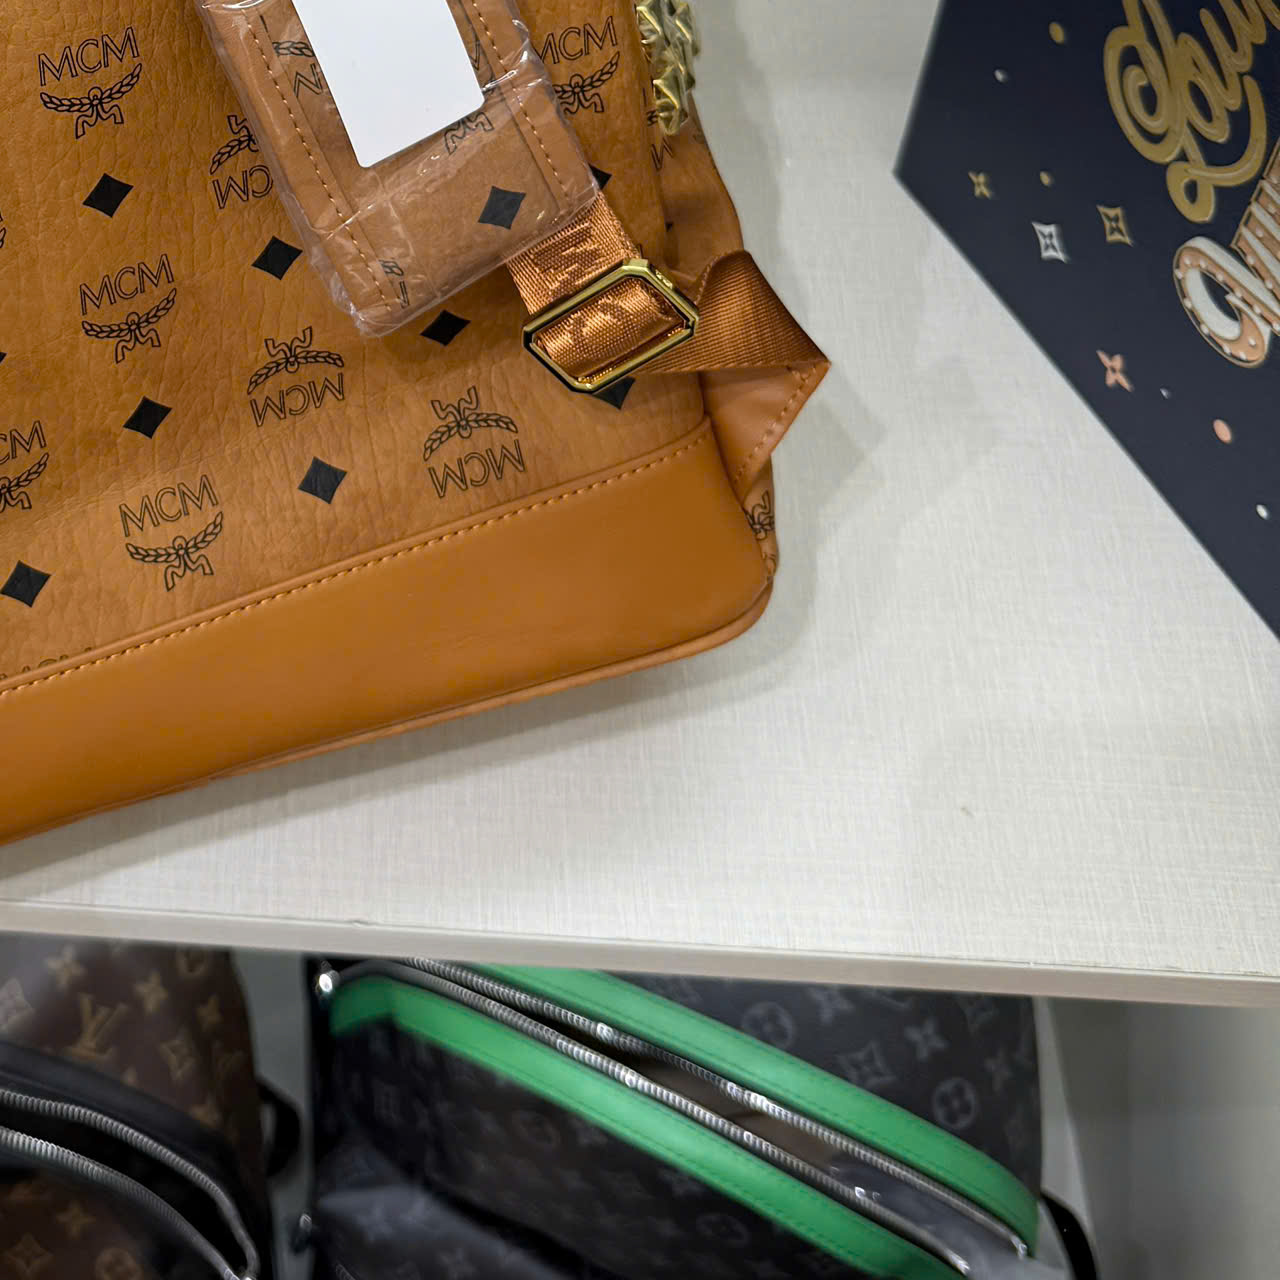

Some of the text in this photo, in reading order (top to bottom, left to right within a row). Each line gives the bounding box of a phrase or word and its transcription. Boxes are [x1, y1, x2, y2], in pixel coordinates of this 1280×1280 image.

[37, 26, 140, 86] MCM
[210, 163, 275, 211] CM
[77, 252, 176, 316] MCM
[250, 372, 347, 427] MCM
[428, 438, 526, 499] MCM
[117, 473, 222, 538] MCM
